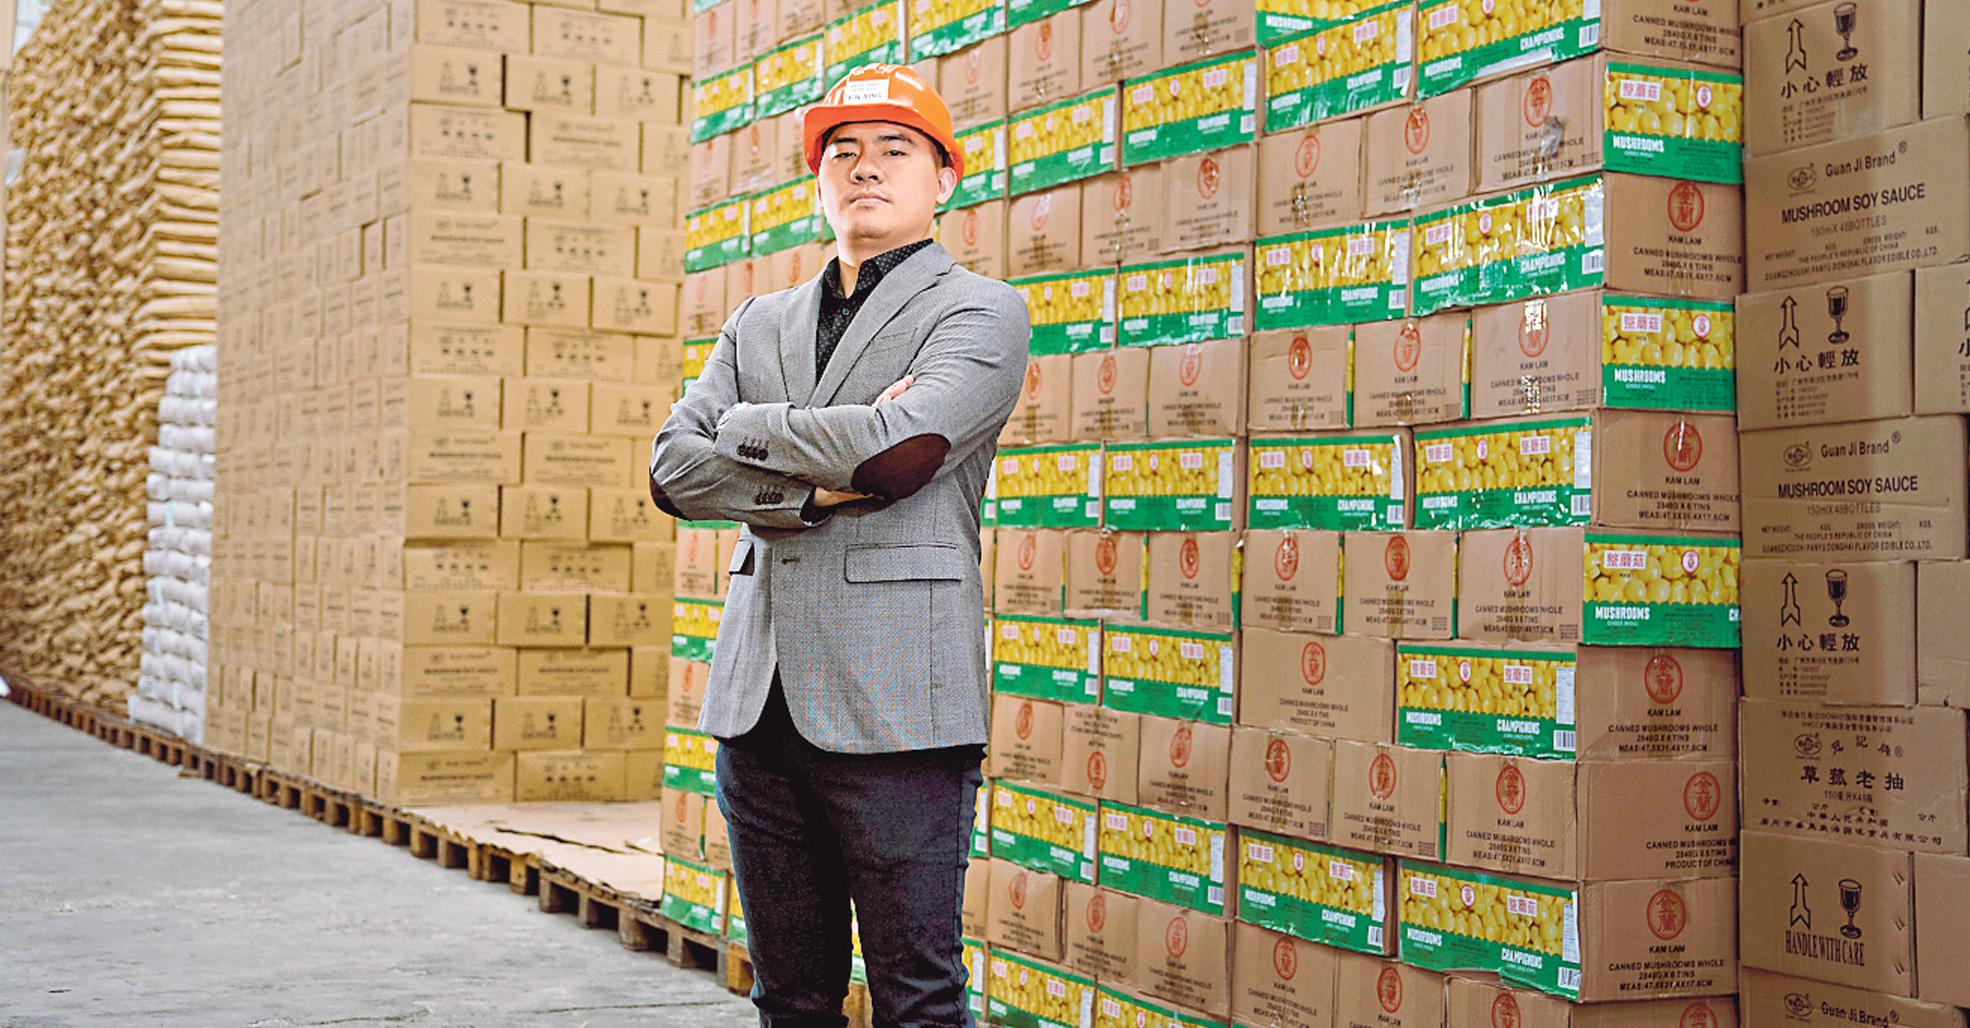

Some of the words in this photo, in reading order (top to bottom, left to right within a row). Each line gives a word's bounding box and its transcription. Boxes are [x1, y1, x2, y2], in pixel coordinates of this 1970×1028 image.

[1613, 136, 1664, 152] MUSHROOMS
[1826, 162, 1850, 177] Guan
[1852, 159, 1862, 173] Ji
[1865, 152, 1896, 169] Brand
[1782, 198, 1850, 223] MUSHROOM
[1853, 192, 1878, 210] SOY
[1881, 184, 1925, 204] SAUCE
[1668, 236, 1684, 244] KAM
[1614, 369, 1666, 384] MUSHROOMS
[1821, 446, 1846, 457] Guan
[1849, 444, 1857, 457] Ji
[1859, 440, 1889, 455] Brand
[1778, 480, 1845, 498] MUSHROOM
[1848, 479, 1872, 495] SOY
[1875, 476, 1918, 493] SAUCE
[1595, 606, 1650, 620] MUSHROOMS
[1777, 633, 1860, 651] 小心輕放
[1665, 709, 1681, 717] LAM
[1685, 824, 1701, 832] KAM
[1680, 840, 1726, 848] MUSHROOMS
[1665, 860, 1701, 868] PRODUCT
[1668, 945, 1685, 953] LAM
[1785, 930, 1818, 959] HANDLE
[1818, 936, 1842, 963] WITH
[1842, 939, 1865, 966] CARE
[1821, 1002, 1846, 1017] Guan
[1859, 1011, 1888, 1028] Brand
